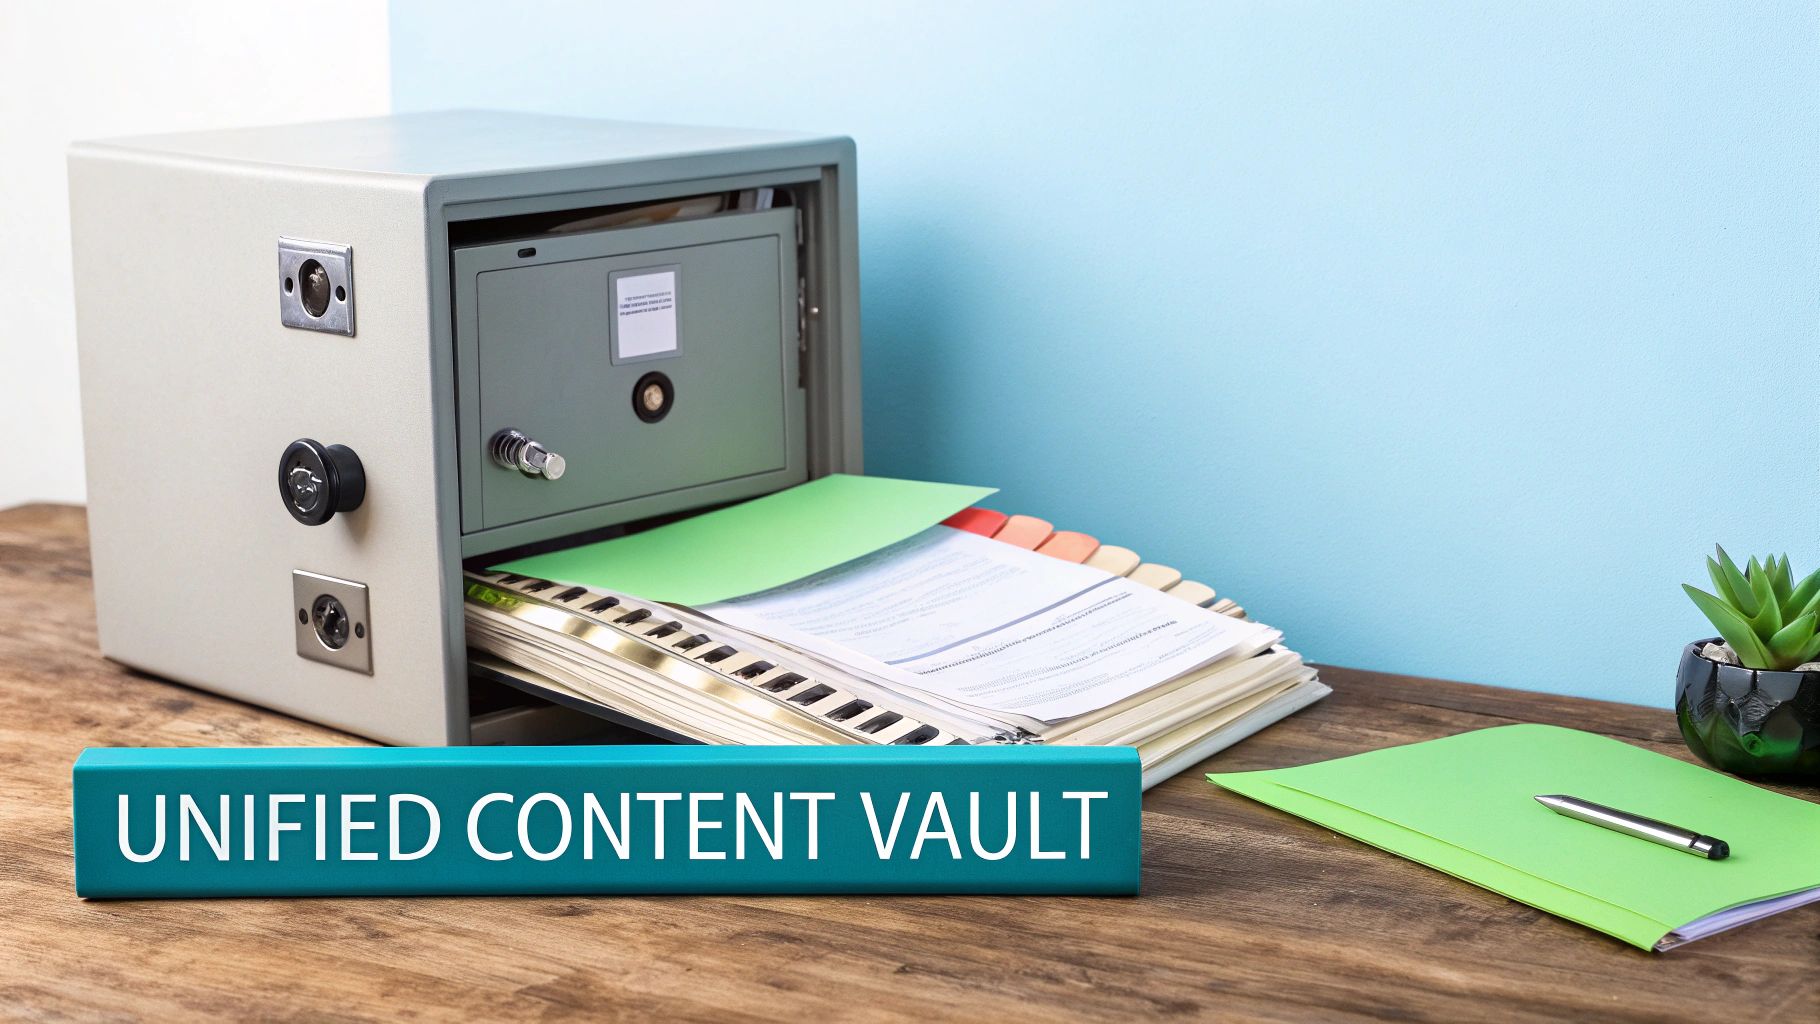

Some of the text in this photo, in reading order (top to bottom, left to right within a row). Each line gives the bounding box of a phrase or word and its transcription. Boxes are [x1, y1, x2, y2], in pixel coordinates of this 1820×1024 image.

[118, 791, 1109, 863] UNIFIED CONTENT VAULT
